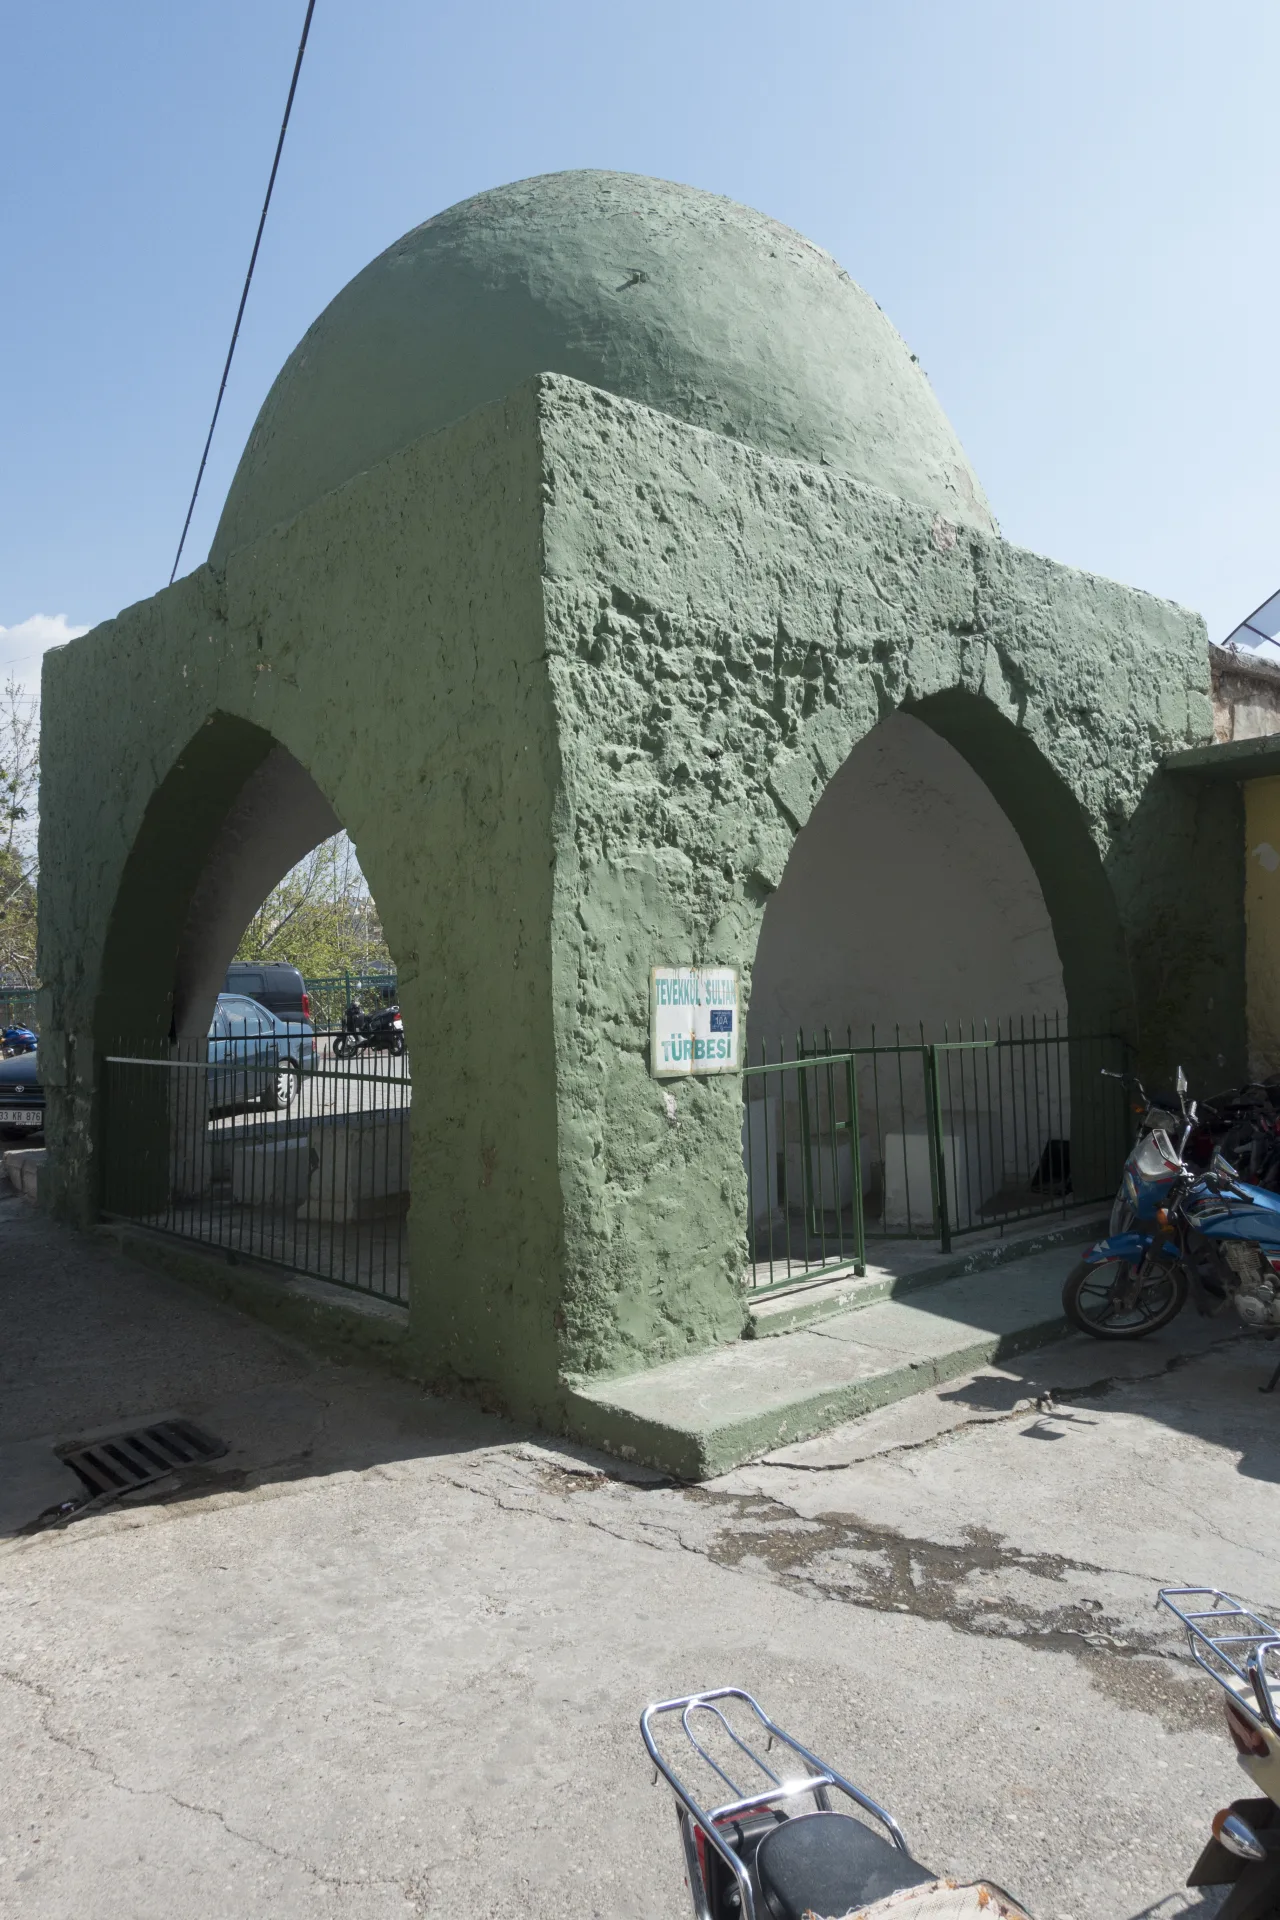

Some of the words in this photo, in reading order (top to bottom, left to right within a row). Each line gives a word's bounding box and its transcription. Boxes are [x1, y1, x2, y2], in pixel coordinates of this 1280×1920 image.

[655, 972, 701, 1006] TEVEKKÜL
[706, 979, 737, 1006] SULTAN
[661, 1032, 732, 1062] TÜRBESİ
